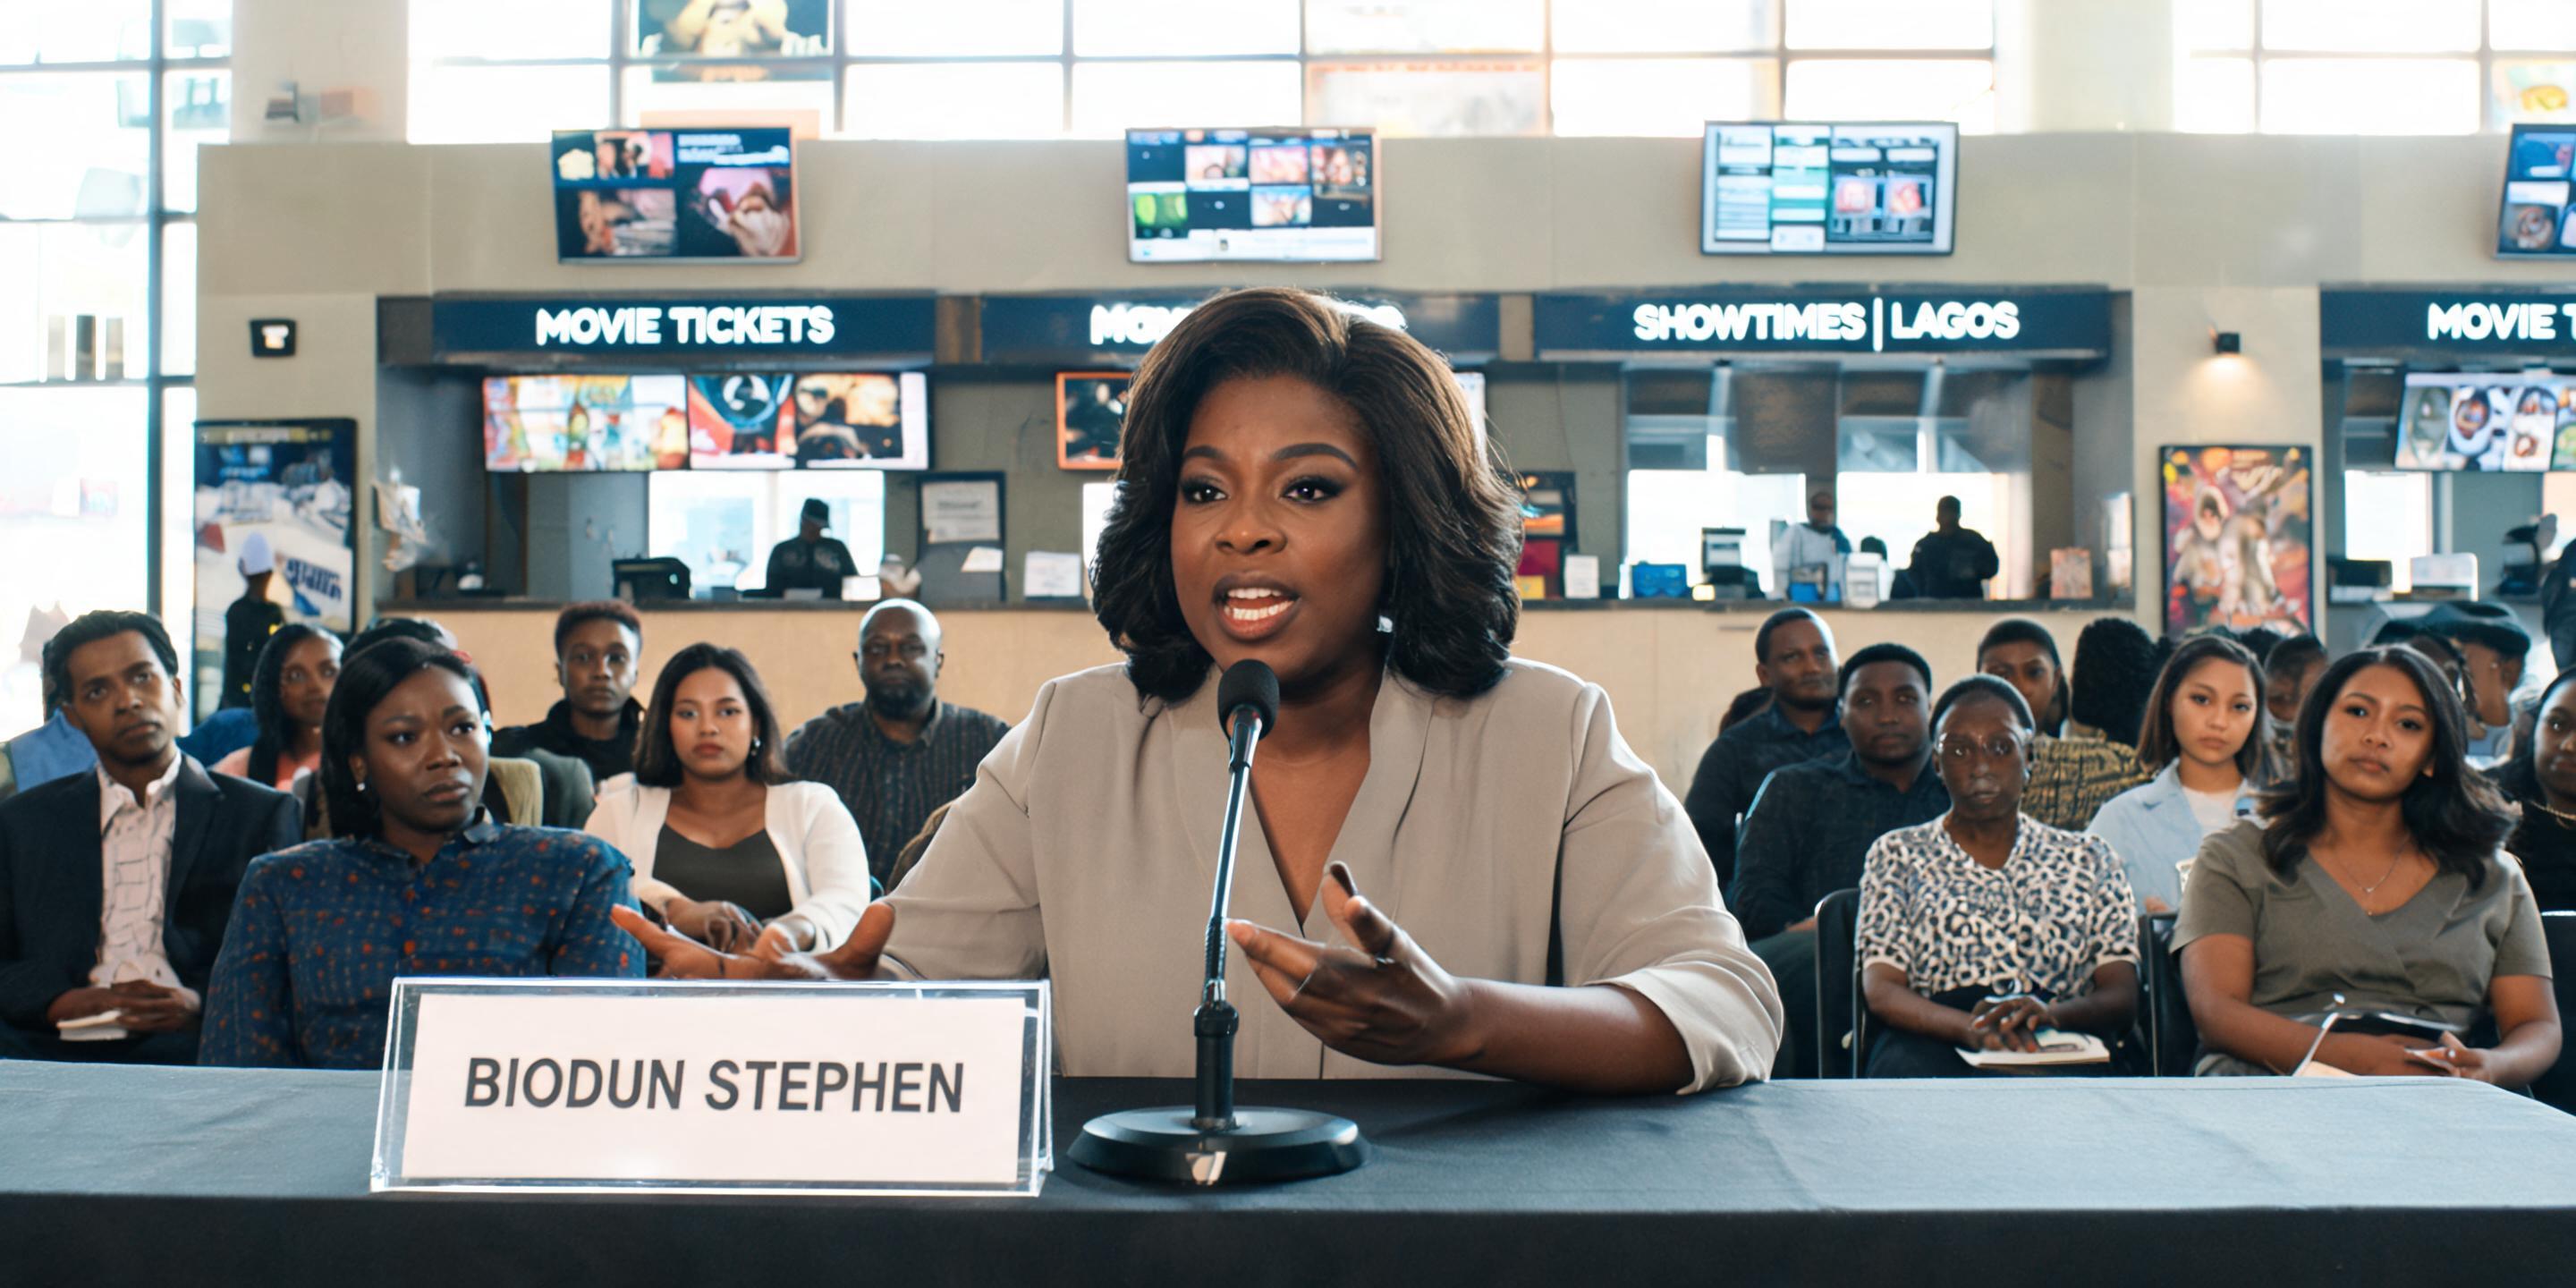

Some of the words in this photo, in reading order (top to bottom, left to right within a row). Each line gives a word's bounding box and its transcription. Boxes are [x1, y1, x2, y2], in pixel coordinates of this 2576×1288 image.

[536, 307, 662, 346] MOVIE
[668, 305, 835, 344] TICKETS
[1632, 301, 1867, 341] SHOWTIMES
[1891, 301, 2021, 340] LAGOS
[2428, 301, 2557, 340] MOVIE
[463, 1057, 685, 1110] BIODUN
[704, 1059, 964, 1113] STEPHEN
